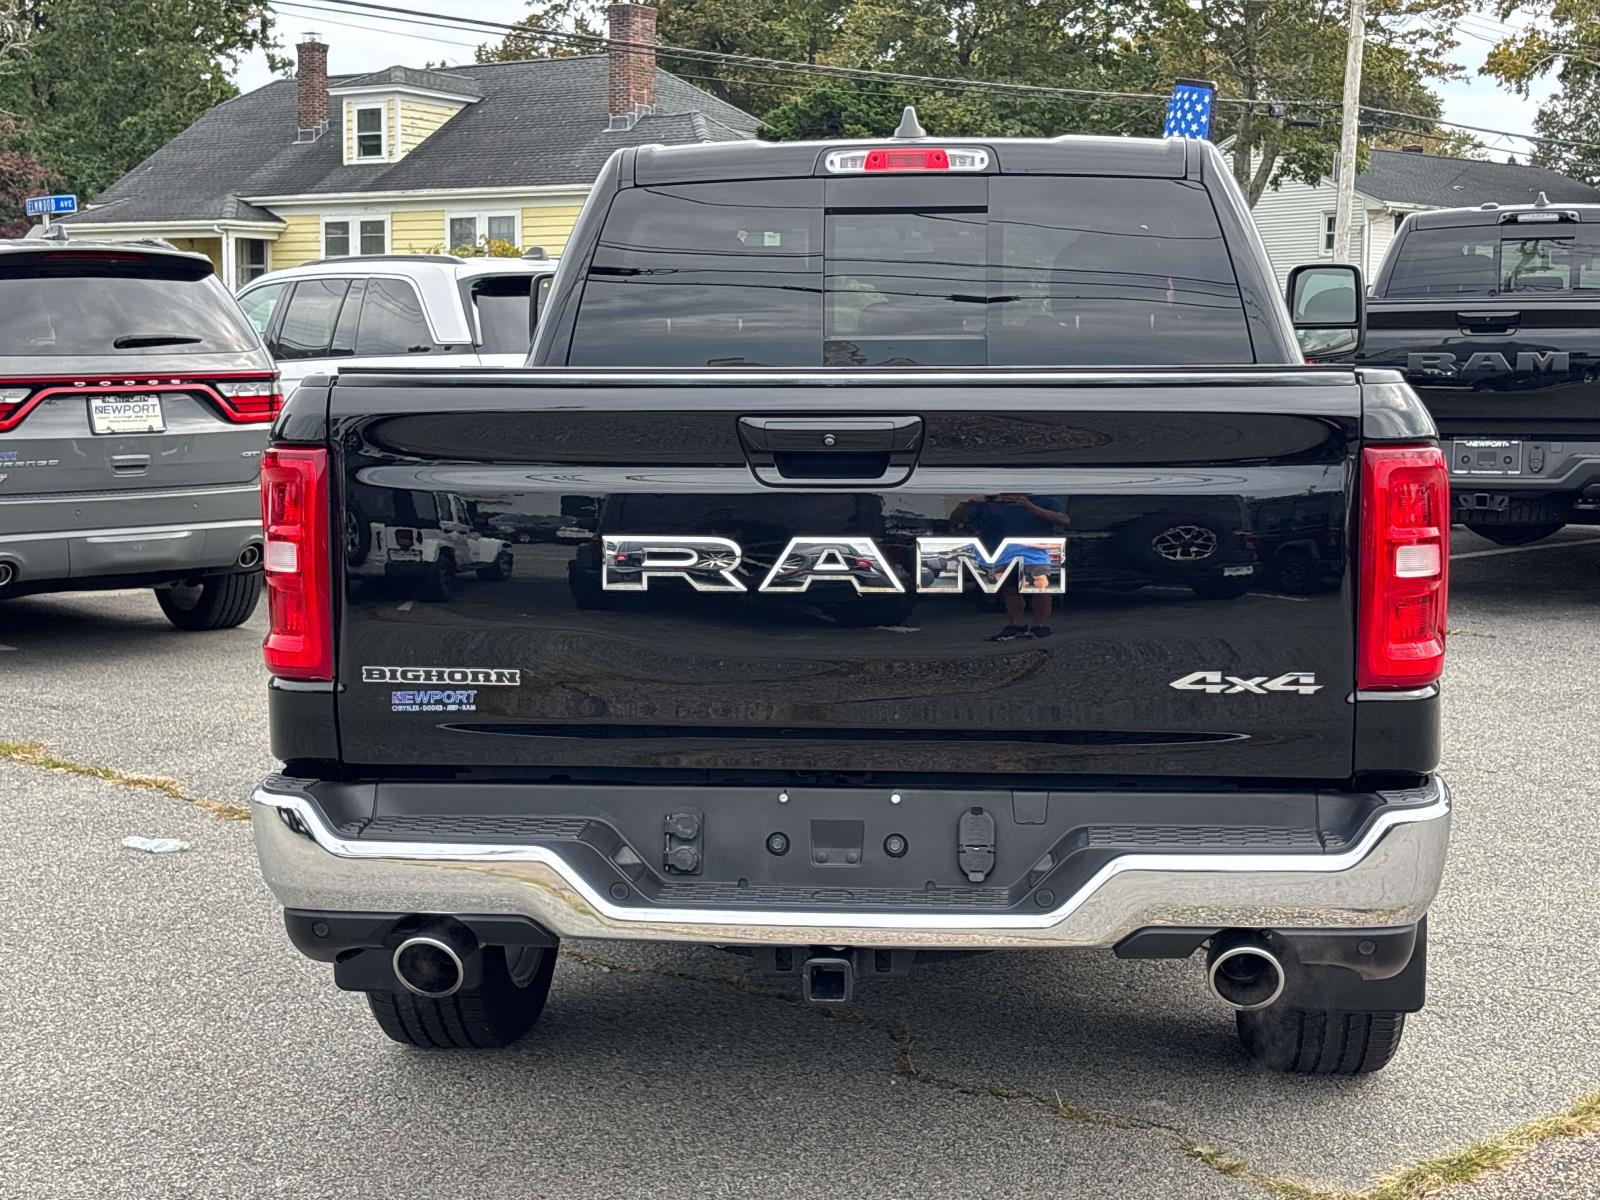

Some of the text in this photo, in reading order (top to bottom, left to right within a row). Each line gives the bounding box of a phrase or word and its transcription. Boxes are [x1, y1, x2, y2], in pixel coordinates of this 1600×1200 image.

[60, 200, 73, 208] AVE
[1407, 351, 1570, 373] RAM
[94, 403, 158, 415] NEWPORT
[1468, 440, 1507, 448] NEWPORT
[602, 535, 1068, 594] RAM
[362, 666, 521, 685] BIGHORN
[391, 690, 478, 704] NEWPORT
